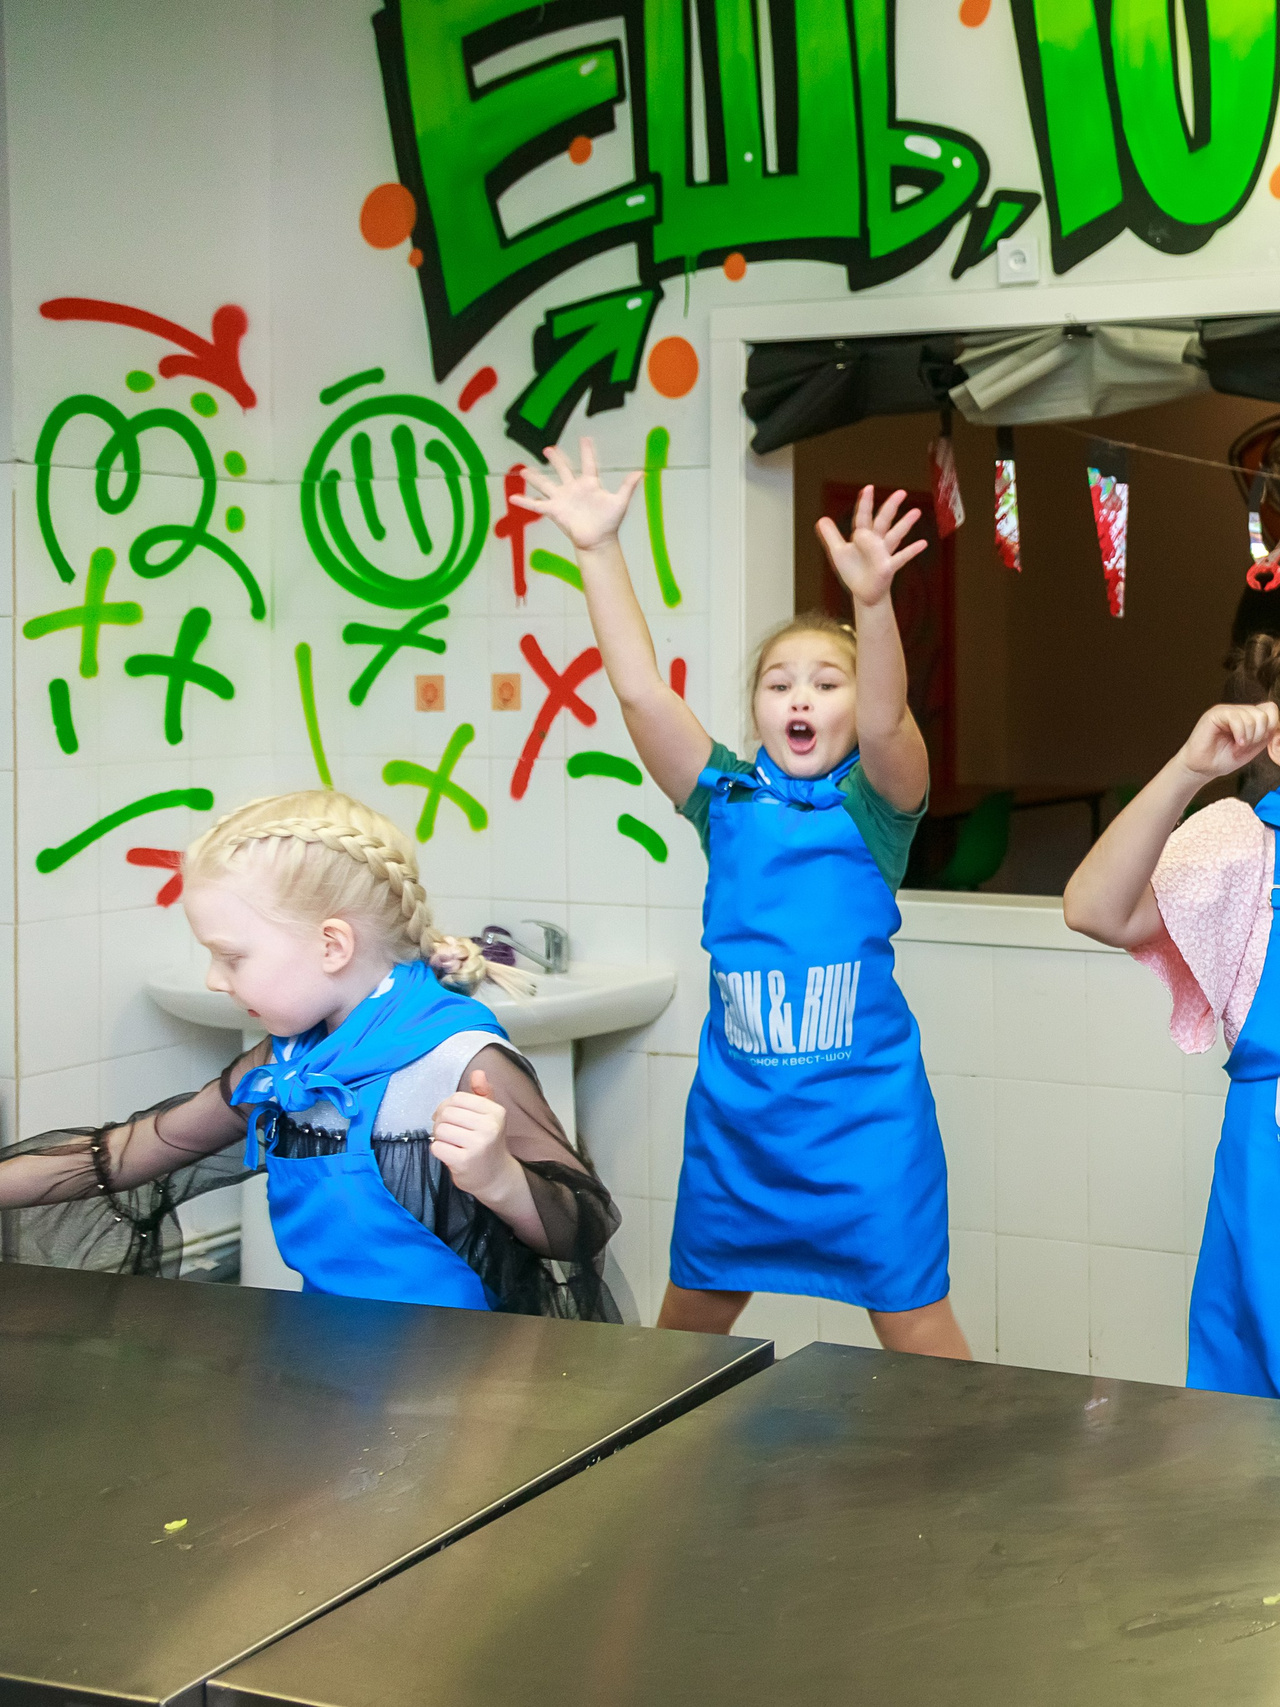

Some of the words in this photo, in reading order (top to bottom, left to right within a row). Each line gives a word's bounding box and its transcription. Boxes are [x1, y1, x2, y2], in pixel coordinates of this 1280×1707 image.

[767, 969, 797, 1055] &
[798, 960, 861, 1053] RUN
[782, 1050, 852, 1067] квест-шоу
